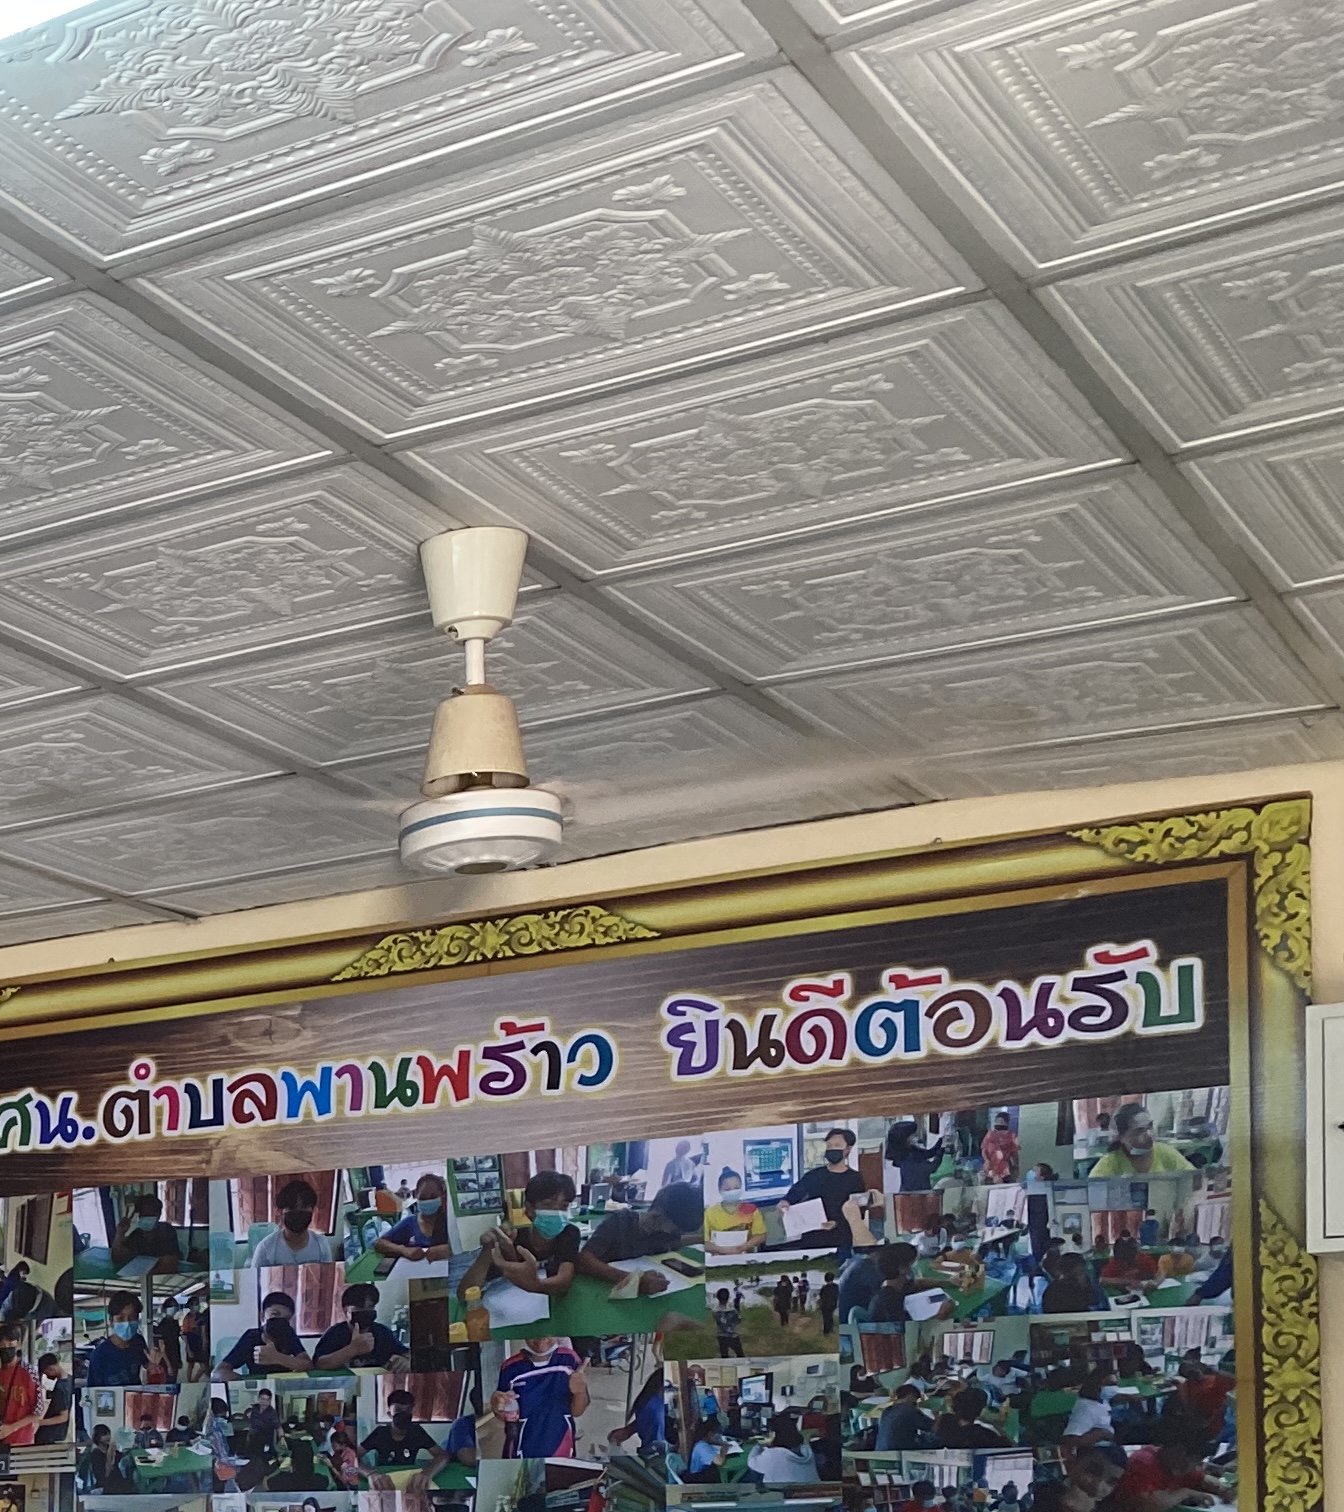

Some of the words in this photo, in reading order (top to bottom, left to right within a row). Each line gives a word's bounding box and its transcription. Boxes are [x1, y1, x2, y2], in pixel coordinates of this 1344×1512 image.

[664, 943, 1202, 1079] ยินดีต้อนรับ
